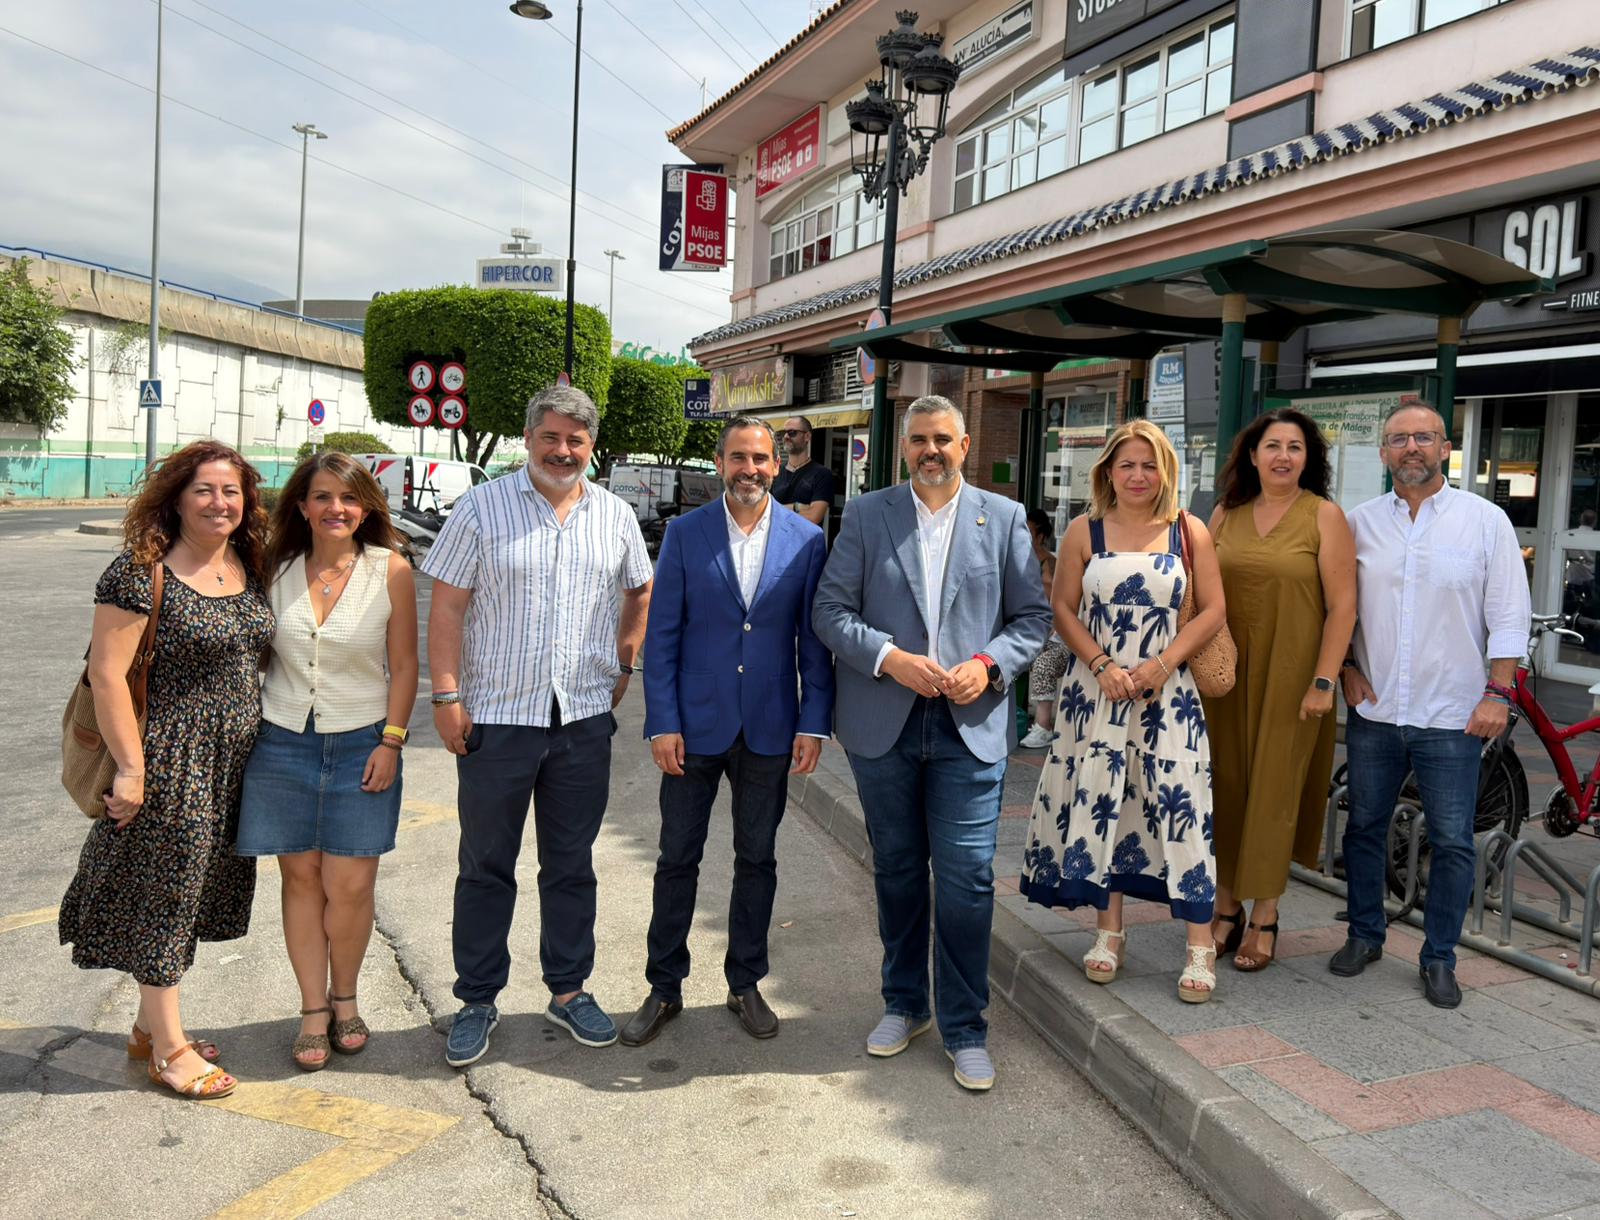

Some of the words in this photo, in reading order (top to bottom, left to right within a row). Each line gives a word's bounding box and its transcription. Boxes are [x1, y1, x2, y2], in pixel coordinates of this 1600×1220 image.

[772, 151, 792, 182] PSOE
[691, 225, 720, 242] Mijas
[1503, 201, 1582, 279] SOL
[687, 242, 723, 260] PSOE
[482, 265, 553, 282] HIPERCOR
[1571, 290, 1600, 308] FITNE
[1162, 361, 1180, 375] RM
[1329, 421, 1339, 431] de
